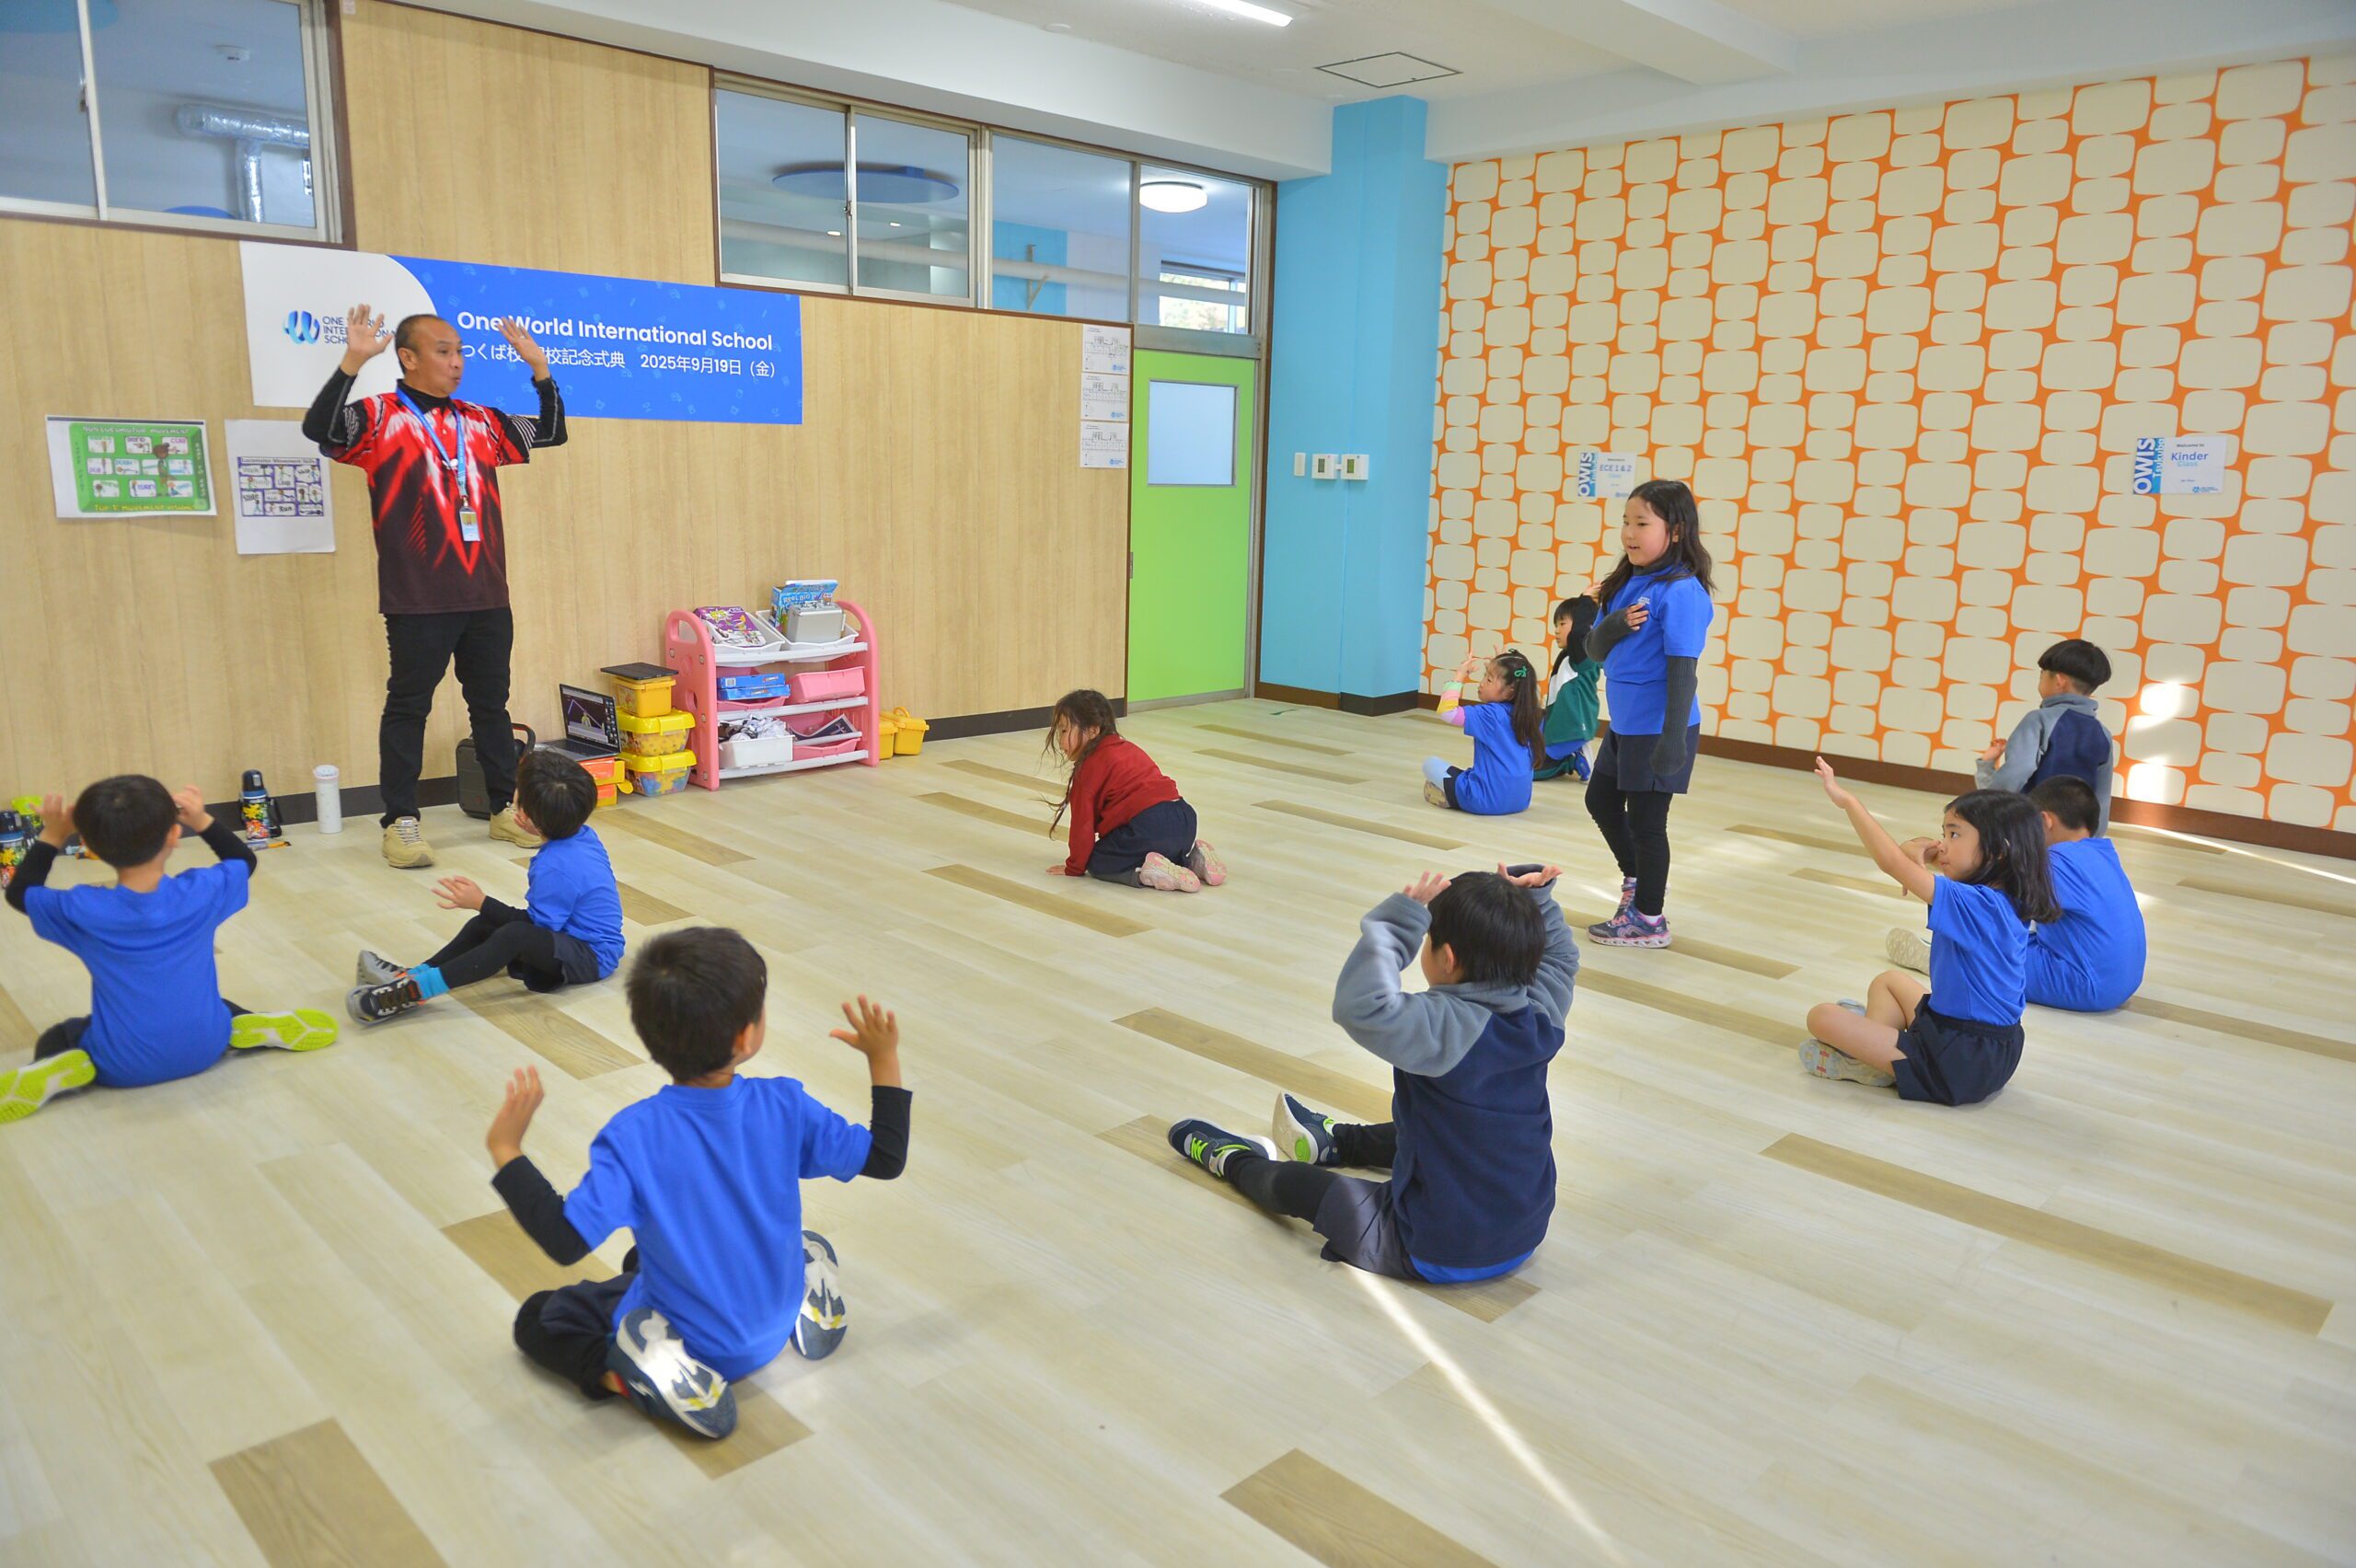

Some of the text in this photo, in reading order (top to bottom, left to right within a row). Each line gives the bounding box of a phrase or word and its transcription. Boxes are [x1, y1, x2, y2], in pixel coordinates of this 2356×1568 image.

[322, 316, 344, 326] ONE
[457, 311, 772, 351] One World International School
[461, 343, 626, 369] つくば校校記念式典
[2134, 438, 2155, 494] OWIS
[2171, 452, 2210, 461] Kinder
[1578, 453, 1592, 497] OWIS
